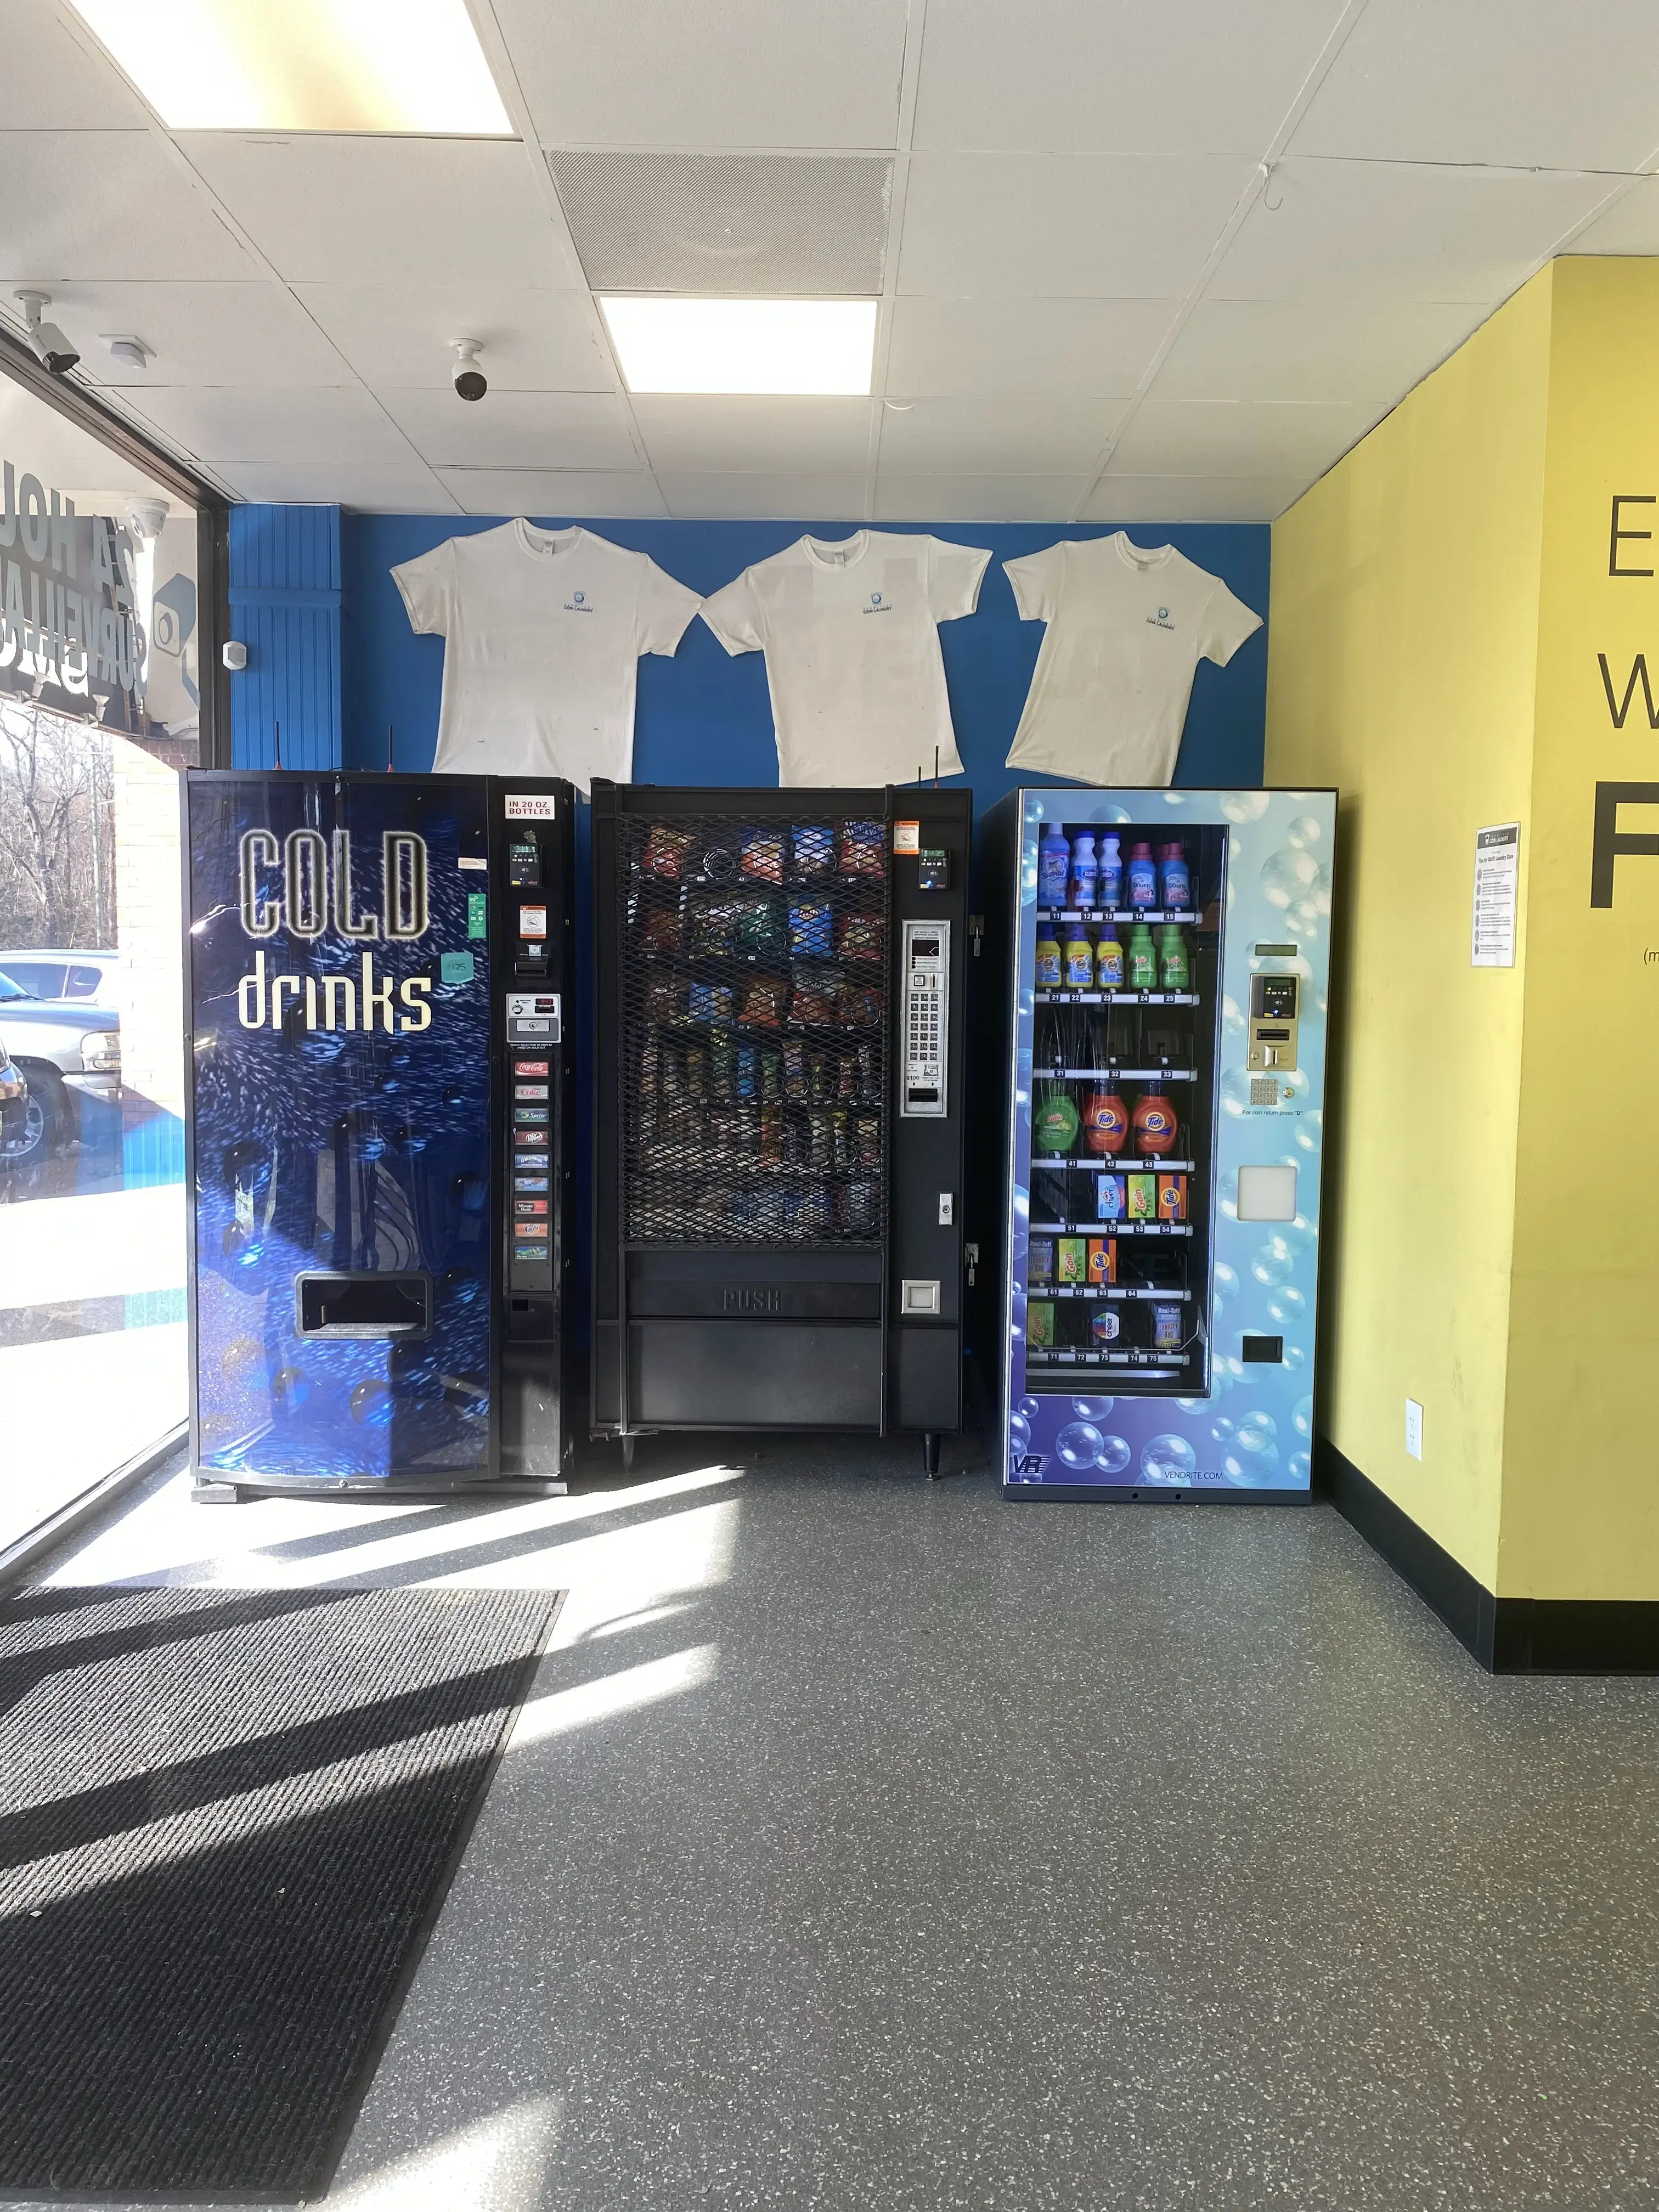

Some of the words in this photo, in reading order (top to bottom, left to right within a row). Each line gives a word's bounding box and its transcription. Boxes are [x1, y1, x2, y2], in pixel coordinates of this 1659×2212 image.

[1156, 622, 1175, 630] LAUNDRY
[239, 828, 428, 939] COLD
[238, 950, 433, 1035] drinks
[1047, 1114, 1063, 1122] Gain
[1098, 1113, 1114, 1125] Tide
[1148, 1116, 1164, 1127] Tide
[1105, 1188, 1114, 1208] cheer
[1135, 1188, 1147, 1209] Gain
[1166, 1189, 1176, 1205] Tide
[1066, 1252, 1077, 1273] Gain
[1095, 1253, 1106, 1269] Tide
[723, 1289, 781, 1312] PUSH
[1034, 1317, 1045, 1336] Gain
[1159, 1322, 1178, 1331] Laundry
[1164, 1471, 1223, 1480] VENDRITE.COM
